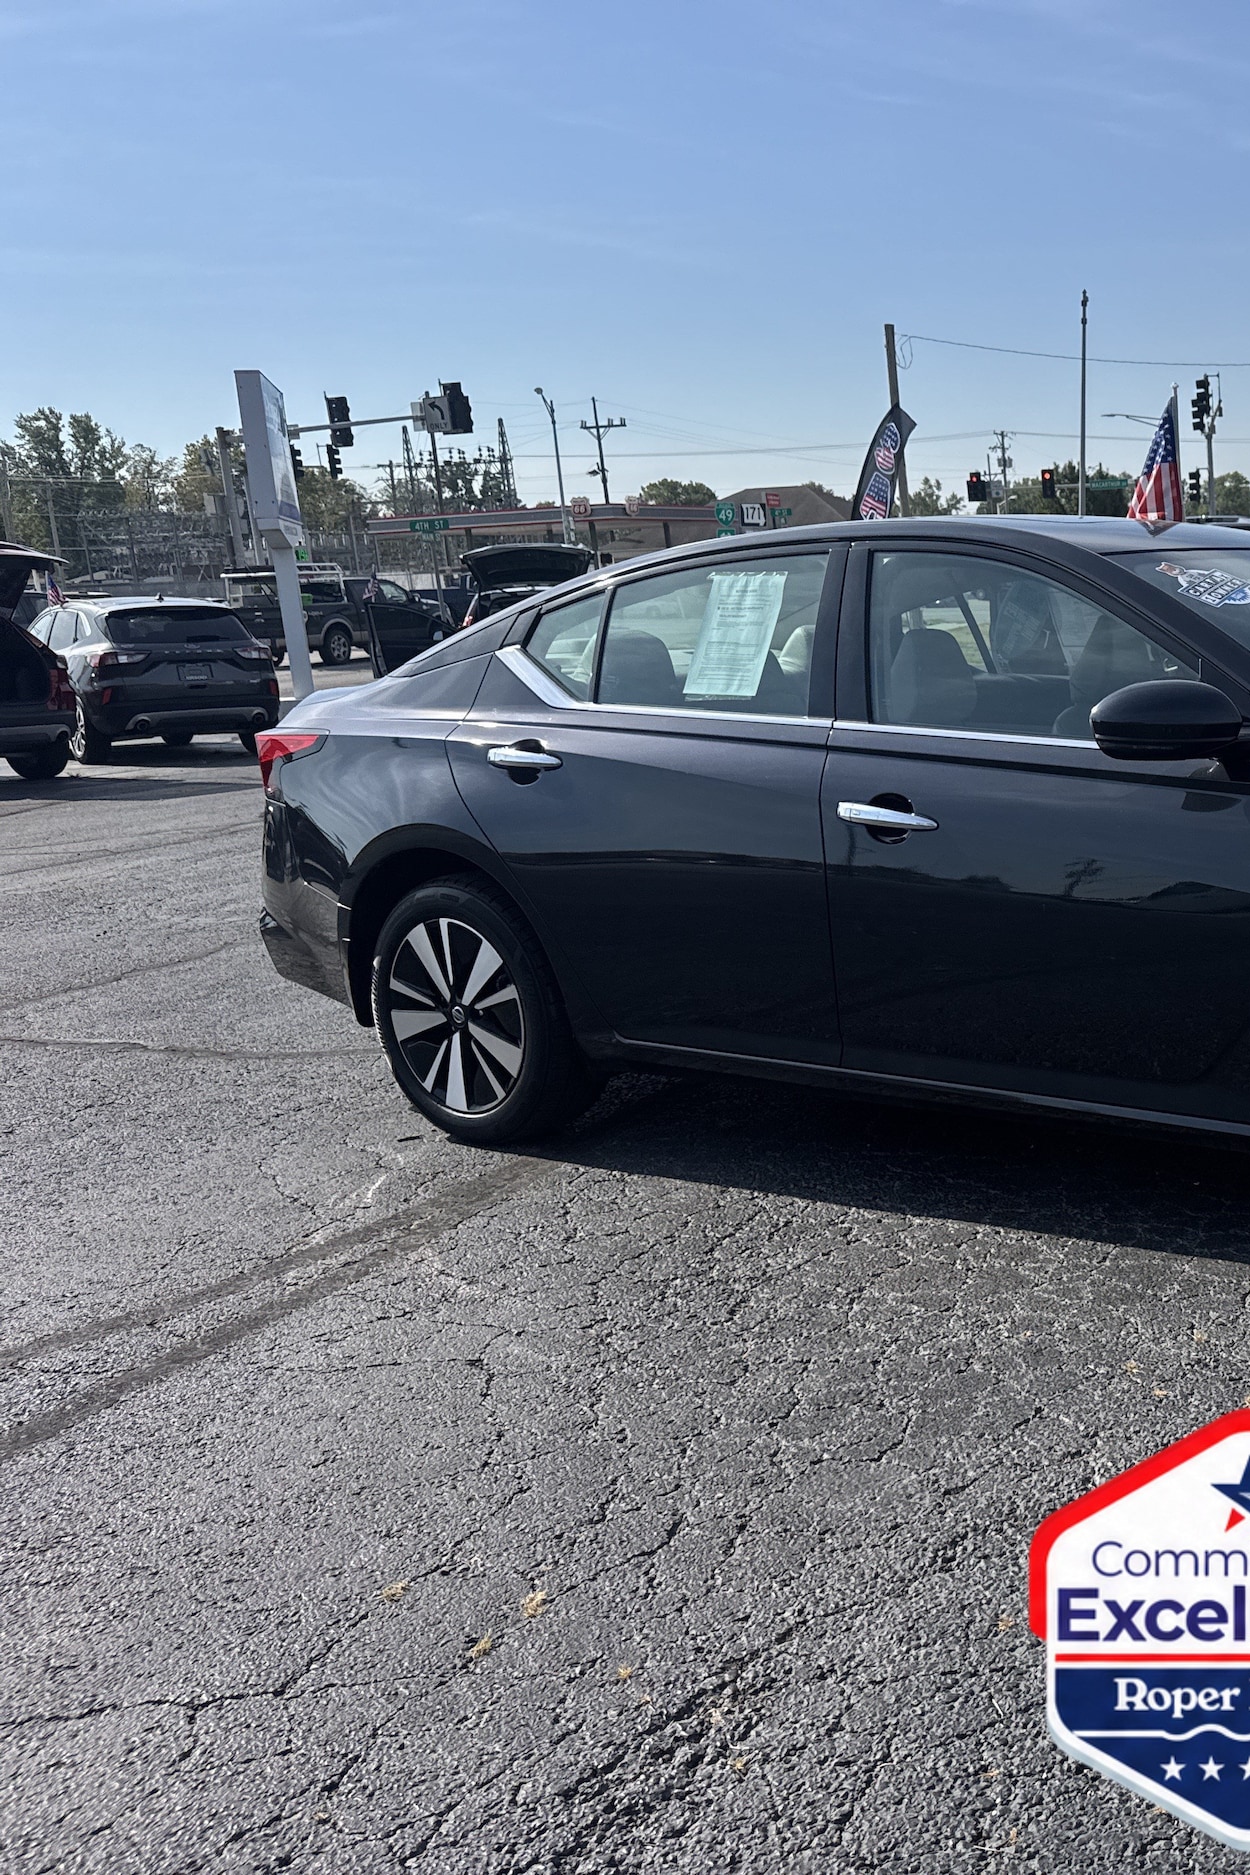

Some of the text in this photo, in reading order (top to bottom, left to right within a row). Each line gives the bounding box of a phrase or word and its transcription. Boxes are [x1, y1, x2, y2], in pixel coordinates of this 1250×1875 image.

[429, 421, 448, 430] ONLY
[574, 505, 586, 514] 66
[745, 506, 761, 521] 171
[718, 509, 733, 521] 49
[415, 520, 444, 530] 4TH ST
